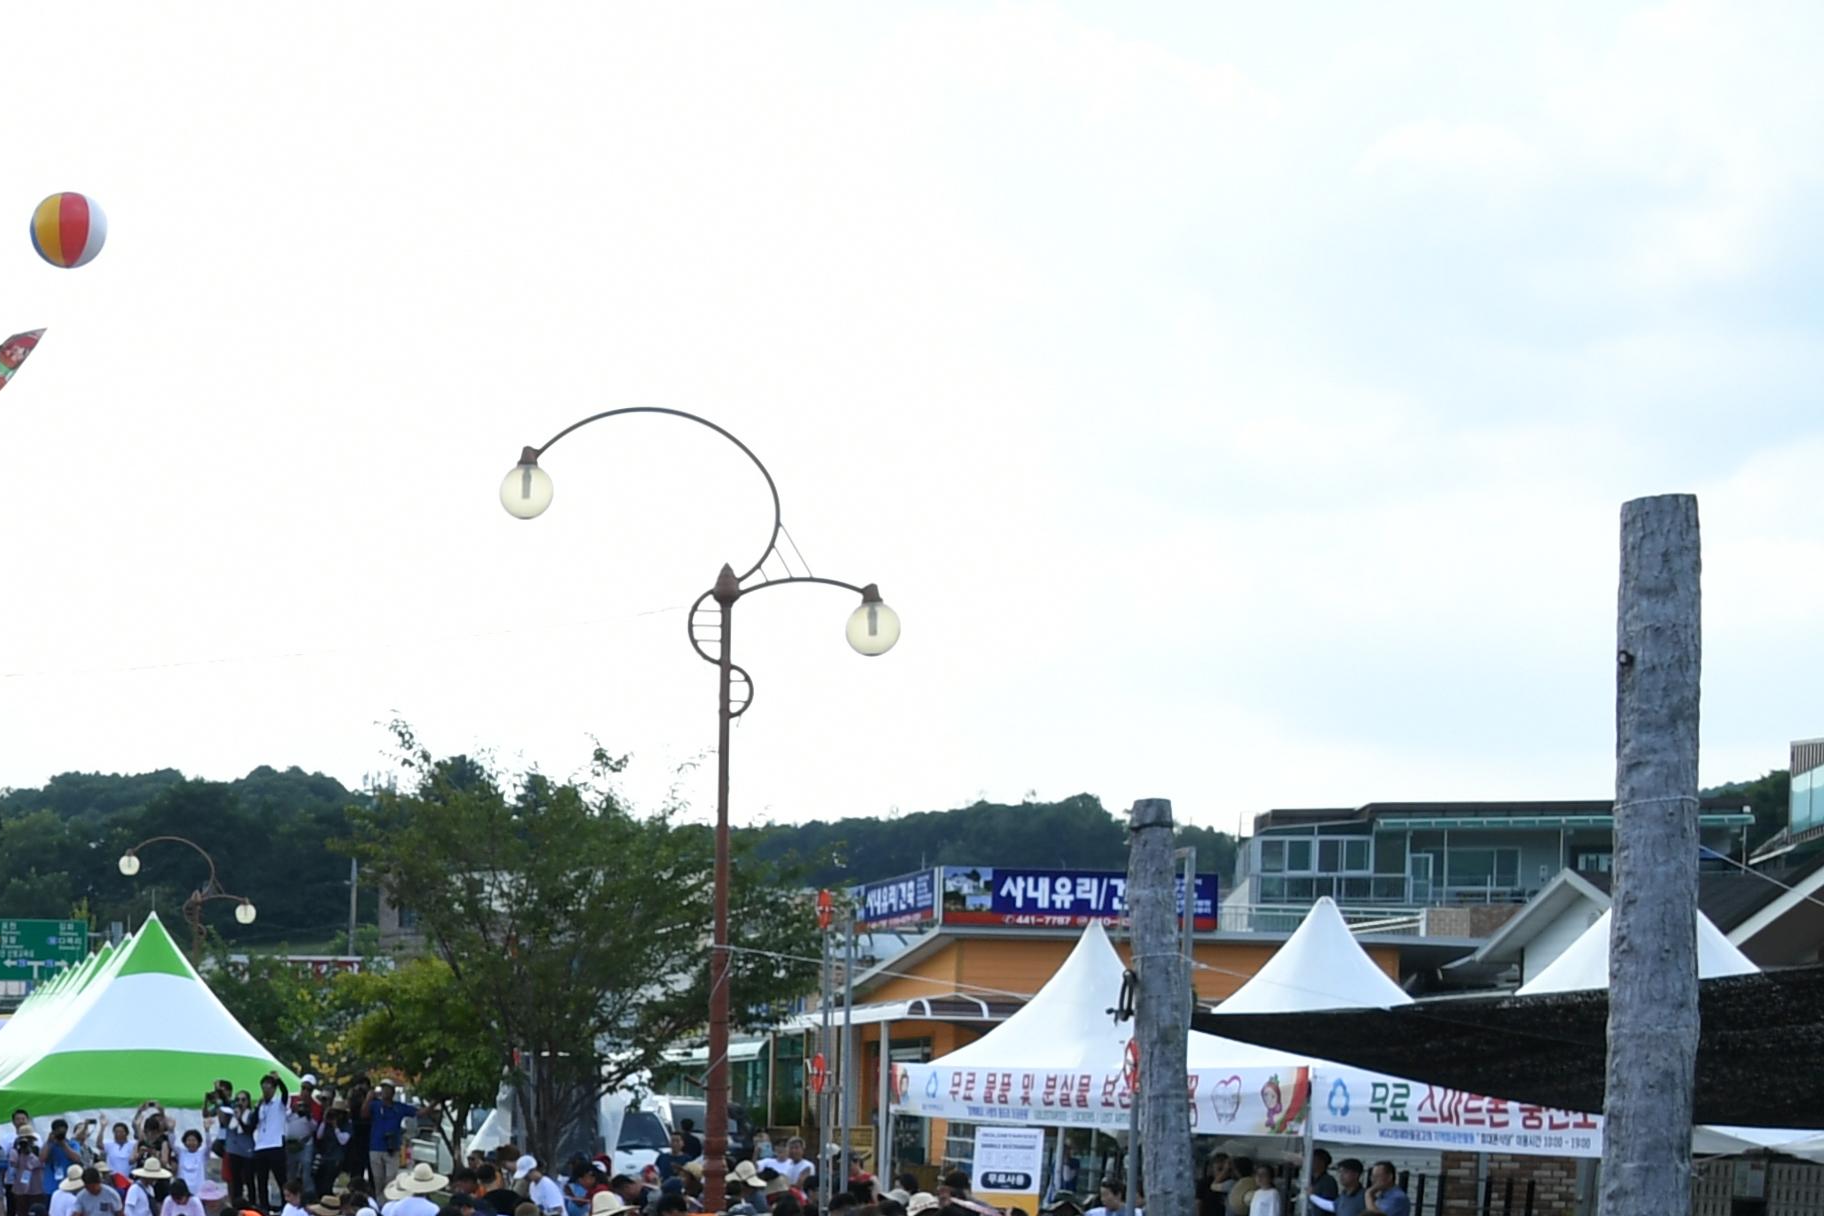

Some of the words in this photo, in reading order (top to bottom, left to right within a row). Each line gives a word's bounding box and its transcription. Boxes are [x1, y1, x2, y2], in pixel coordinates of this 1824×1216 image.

[949, 1071, 976, 1102] 무료
[984, 1072, 1012, 1105] 물품
[1020, 1073, 1035, 1106] 및
[1042, 1074, 1092, 1109] 분실물
[1369, 1081, 1411, 1124] 무료
